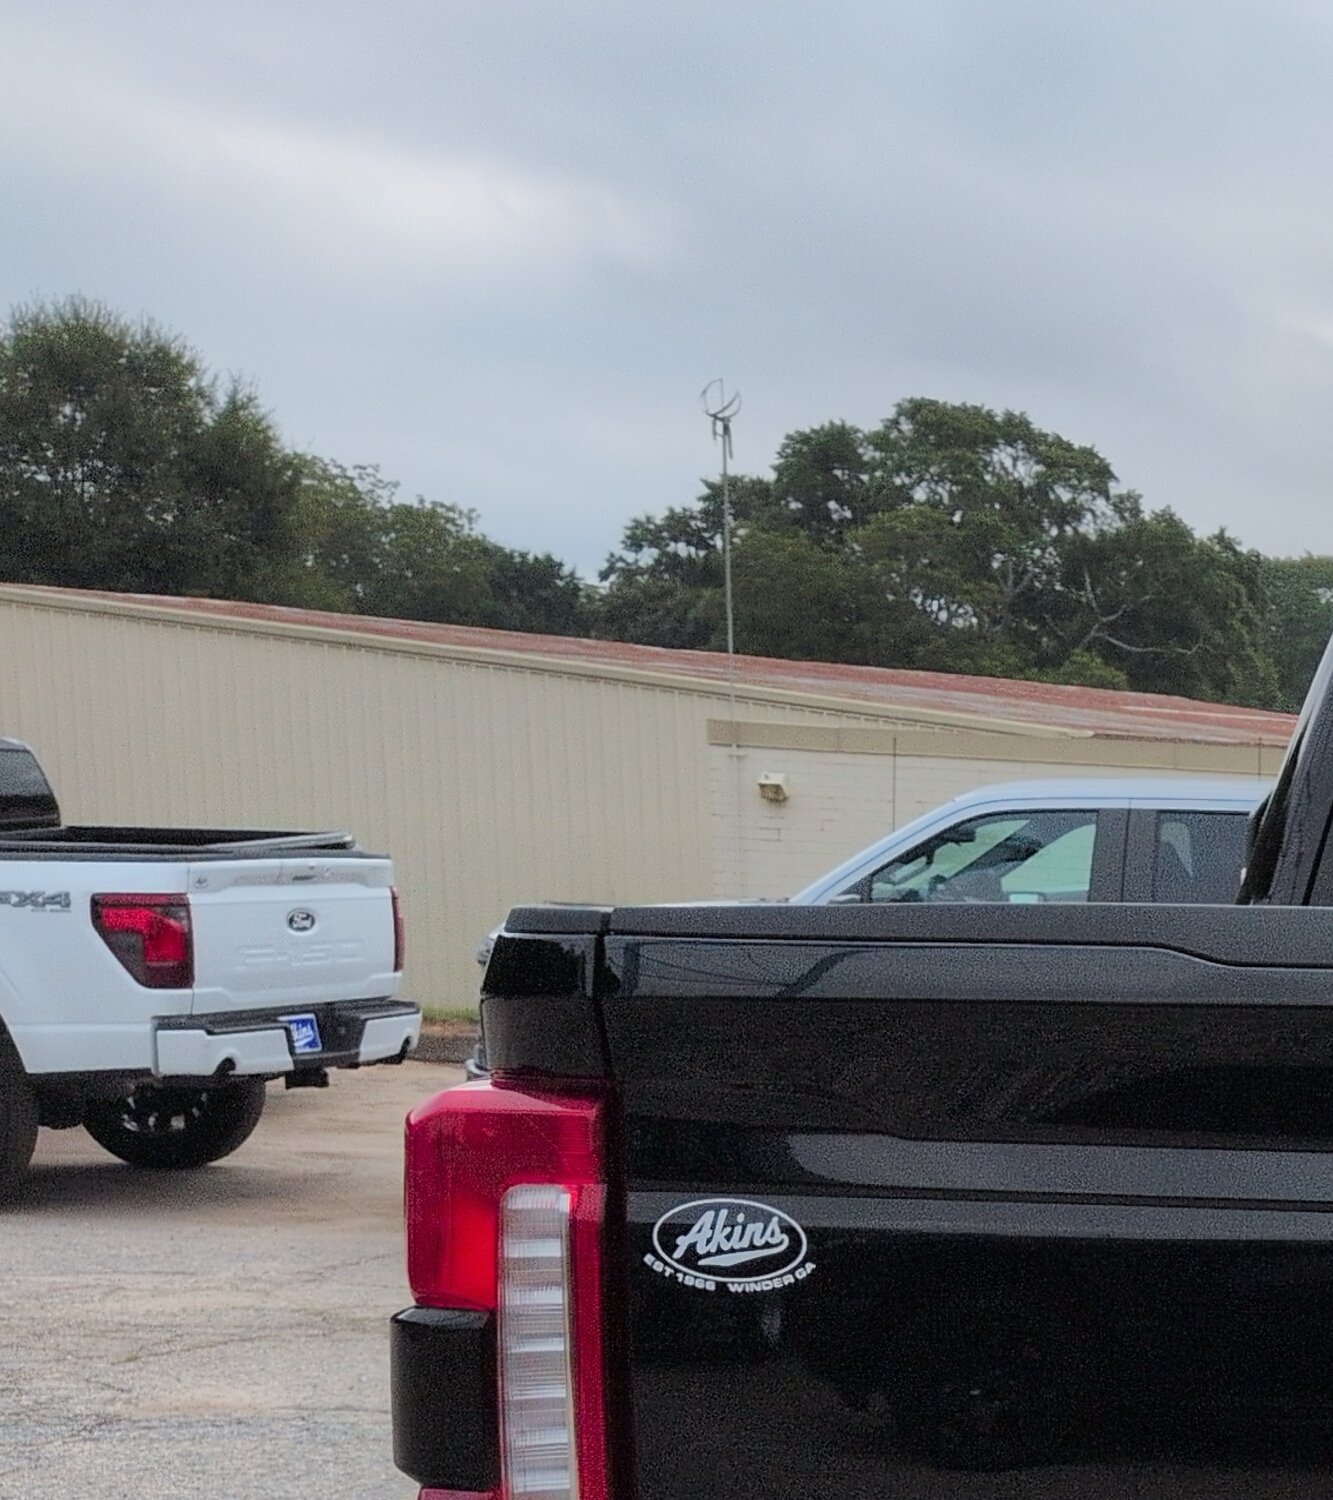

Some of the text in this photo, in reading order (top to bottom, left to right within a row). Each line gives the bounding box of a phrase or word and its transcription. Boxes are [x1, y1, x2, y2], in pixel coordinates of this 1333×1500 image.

[674, 1209, 789, 1265] Akins
[643, 1253, 675, 1278] EST
[727, 1275, 795, 1292] WINDER
[797, 1261, 816, 1279] GA
